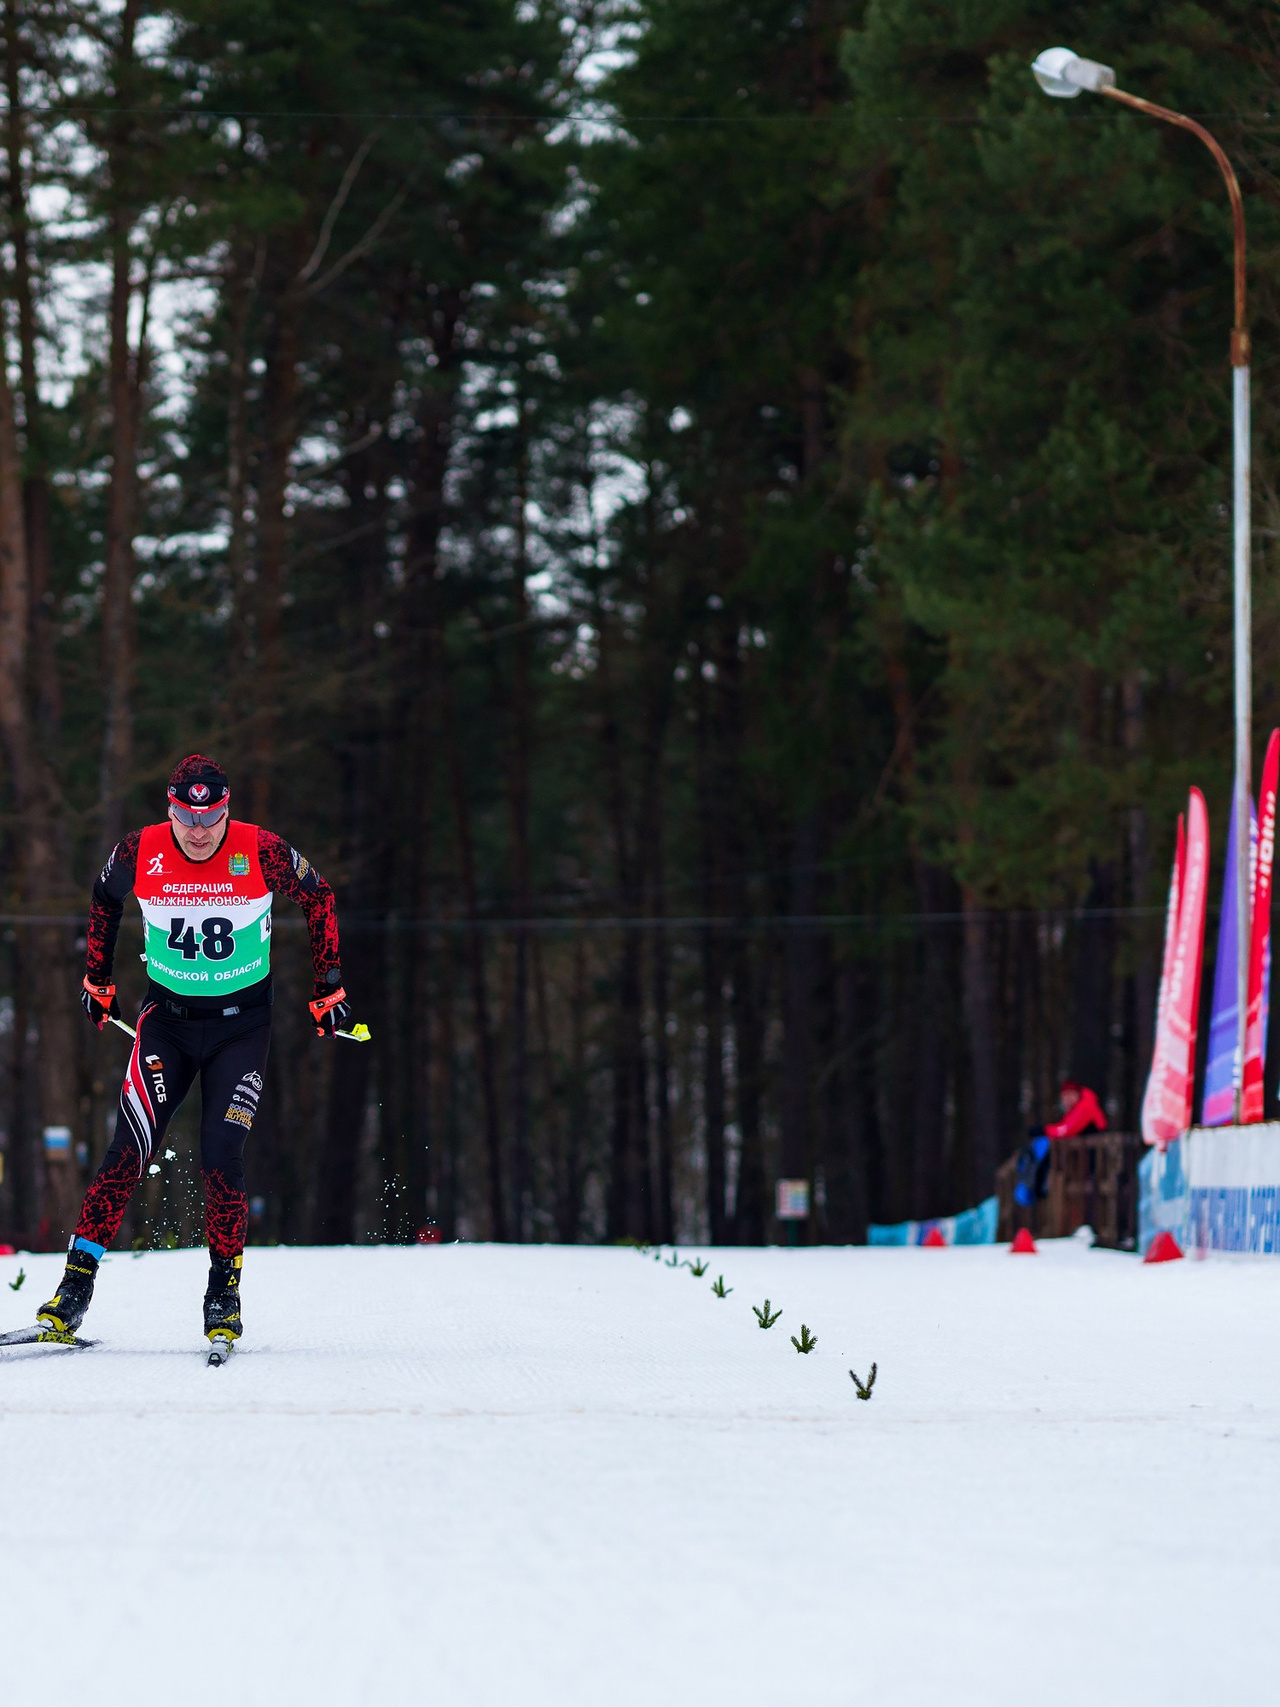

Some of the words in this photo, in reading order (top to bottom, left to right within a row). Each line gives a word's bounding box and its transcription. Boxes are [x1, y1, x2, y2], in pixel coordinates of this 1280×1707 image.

[162, 883, 234, 895] ФЕДЕРАЦИЯ
[148, 896, 205, 906] ЛЫЖНЫХ
[208, 895, 250, 906] ГОНОК
[167, 916, 236, 961] 48
[214, 956, 262, 981] ОБЛАСТИ
[152, 1072, 167, 1103] ПСБ
[66, 1263, 92, 1275] SCHER
